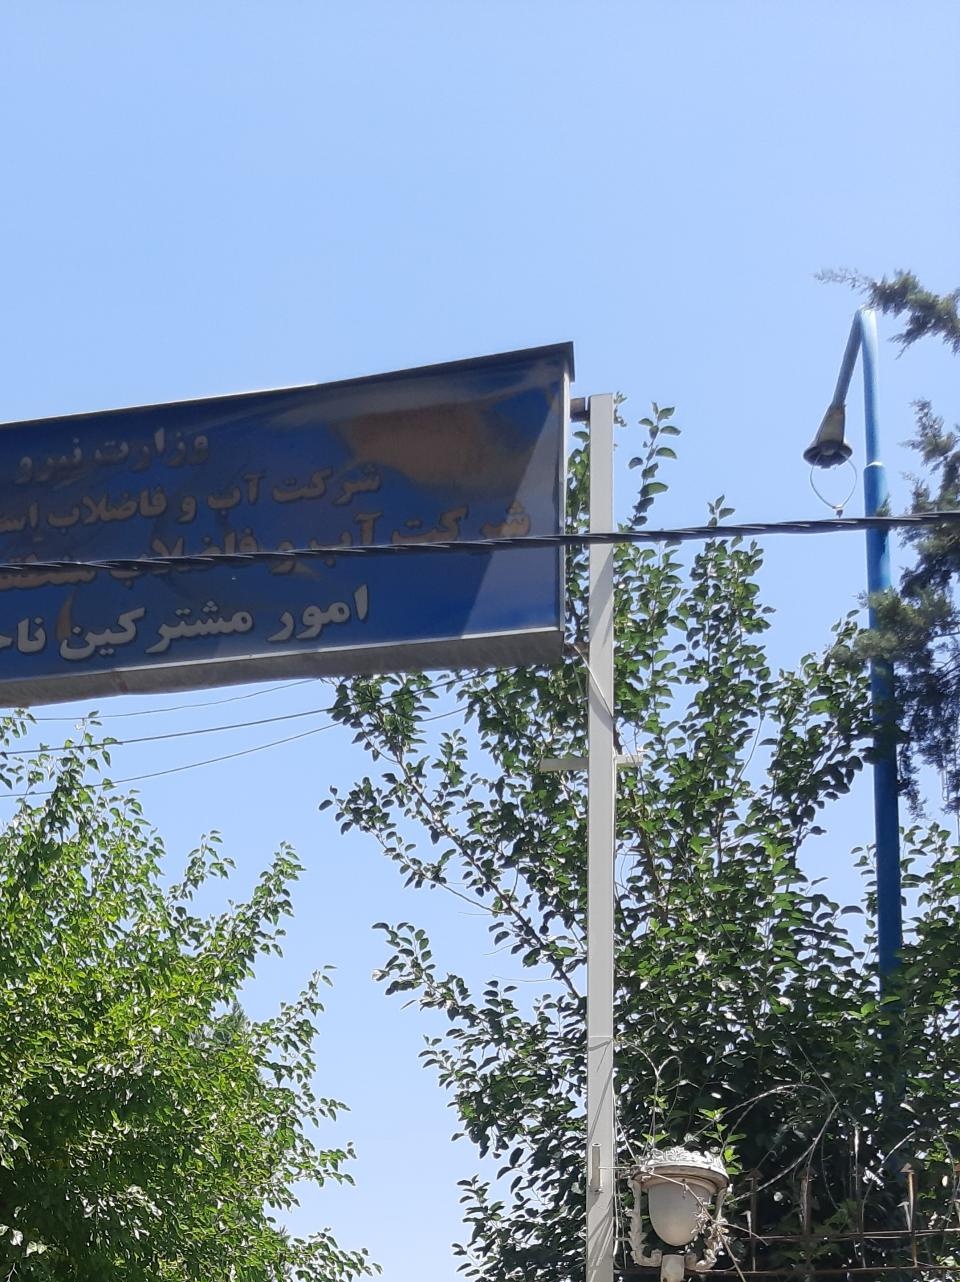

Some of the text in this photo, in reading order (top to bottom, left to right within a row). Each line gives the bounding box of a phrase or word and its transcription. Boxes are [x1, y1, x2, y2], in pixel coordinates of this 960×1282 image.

[15, 426, 208, 485] وزارت نیرو
[177, 496, 197, 522] و
[207, 473, 264, 516] آب
[272, 464, 382, 505] شرکت
[47, 486, 167, 535] فاضلاب
[59, 601, 254, 660] مشترکین
[267, 584, 368, 643] امور
